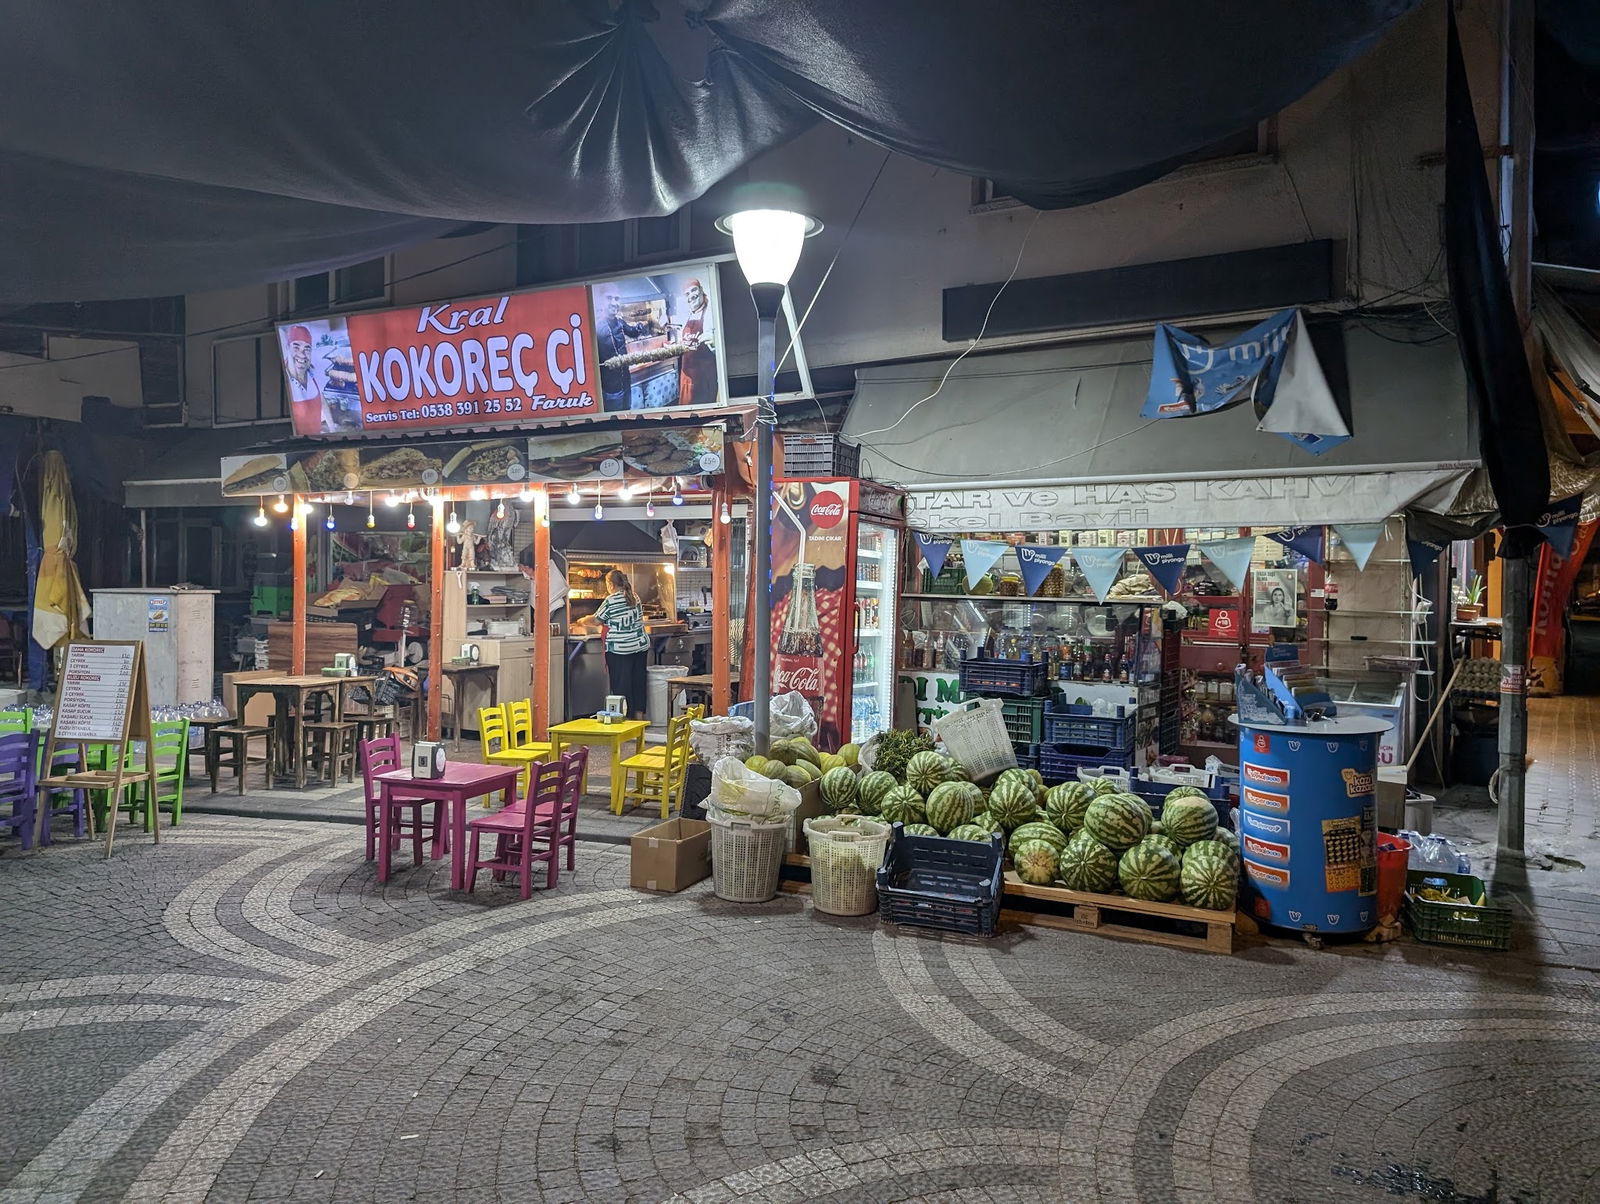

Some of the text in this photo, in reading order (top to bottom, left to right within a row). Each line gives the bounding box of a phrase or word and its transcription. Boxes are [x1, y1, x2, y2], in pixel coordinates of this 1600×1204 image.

[416, 295, 510, 335] Kral
[358, 312, 587, 403] KOKOREÇ Çİ
[366, 397, 522, 423] Servis Tel: 0538 391 25 52
[530, 392, 594, 411] Faruk
[1003, 490, 1058, 507] ve
[1074, 483, 1177, 505] HAS
[810, 504, 842, 516] Coca-Cola
